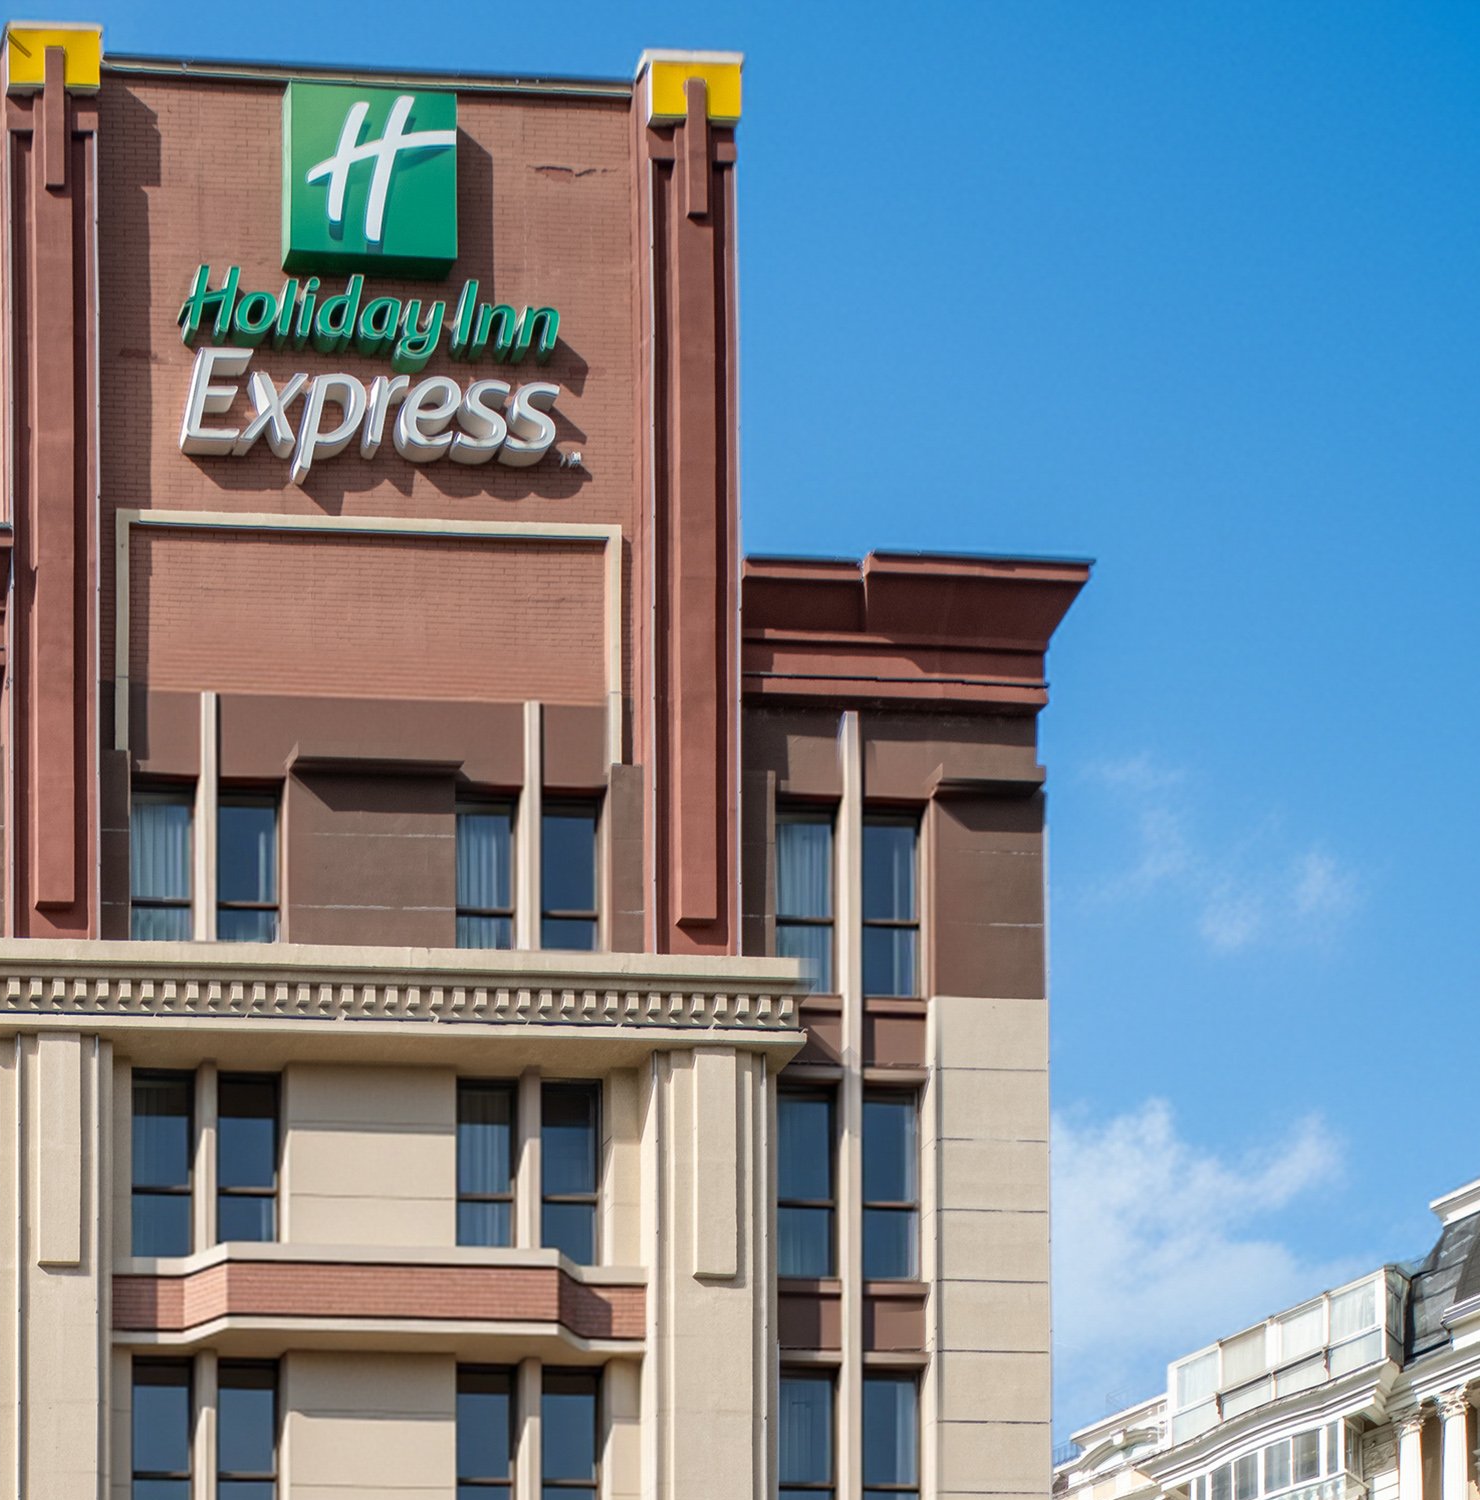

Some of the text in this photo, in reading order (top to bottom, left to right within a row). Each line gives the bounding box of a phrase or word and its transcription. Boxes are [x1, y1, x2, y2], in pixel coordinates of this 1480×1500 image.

[179, 265, 560, 373] Holiday Inn
[179, 347, 561, 485] Express
